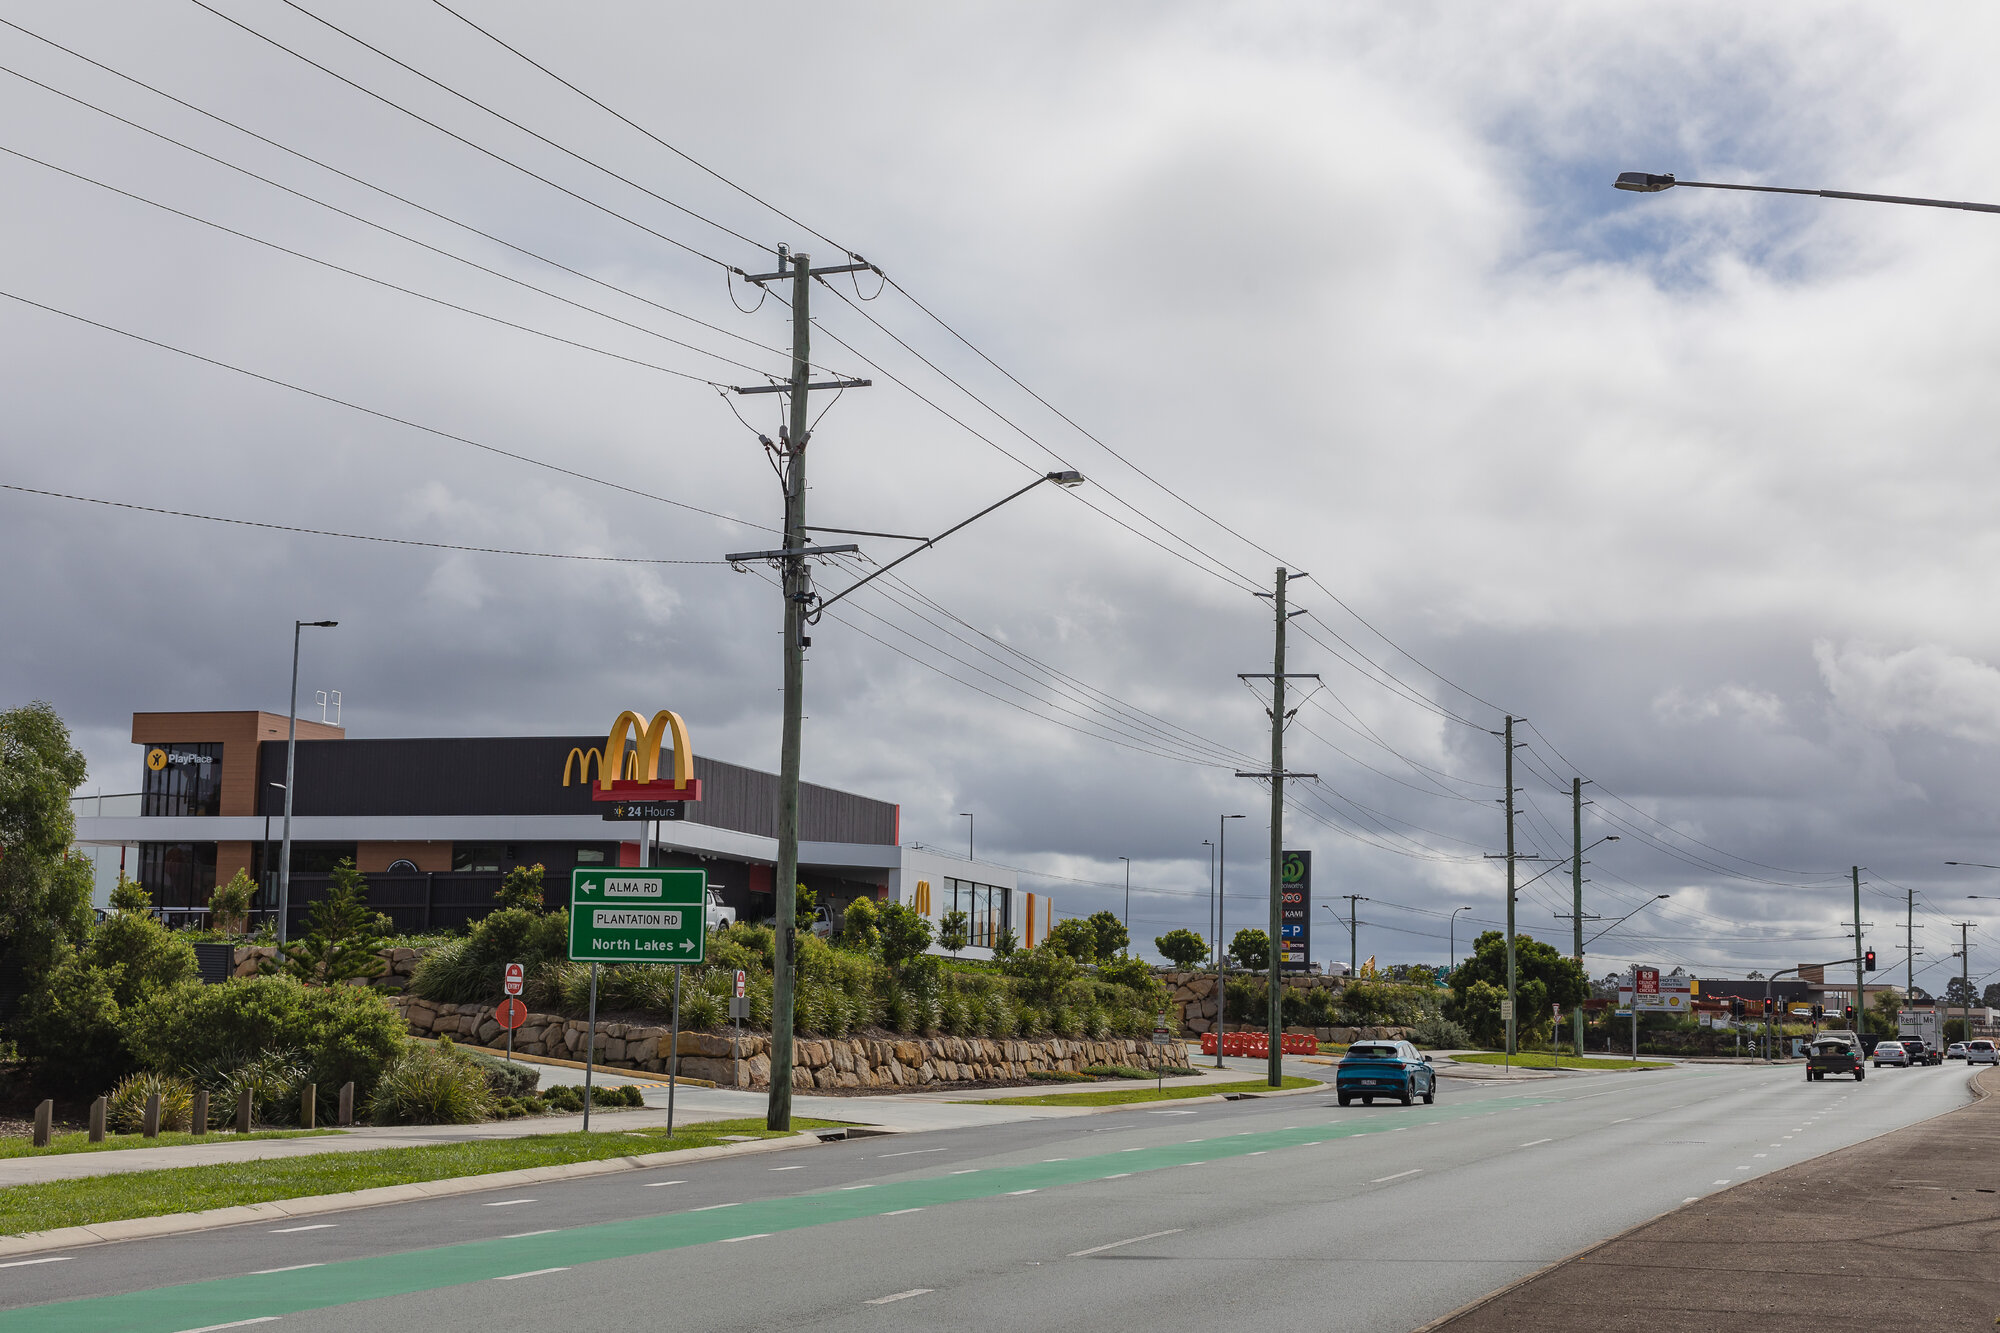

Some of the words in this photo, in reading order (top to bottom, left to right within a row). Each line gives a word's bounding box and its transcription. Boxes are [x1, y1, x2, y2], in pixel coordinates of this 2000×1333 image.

[168, 754, 213, 765] PlayPlace
[627, 806, 641, 817] 24
[644, 806, 675, 817] Hours
[608, 883, 639, 892] ALMA
[643, 883, 658, 893] RD
[596, 914, 660, 925] PLANTATION
[664, 915, 678, 925] RD
[1293, 926, 1300, 936] P
[592, 938, 630, 950] North
[635, 939, 674, 951] Lakes
[1901, 1016, 1916, 1024] Rent
[1923, 1016, 1934, 1024] Me
